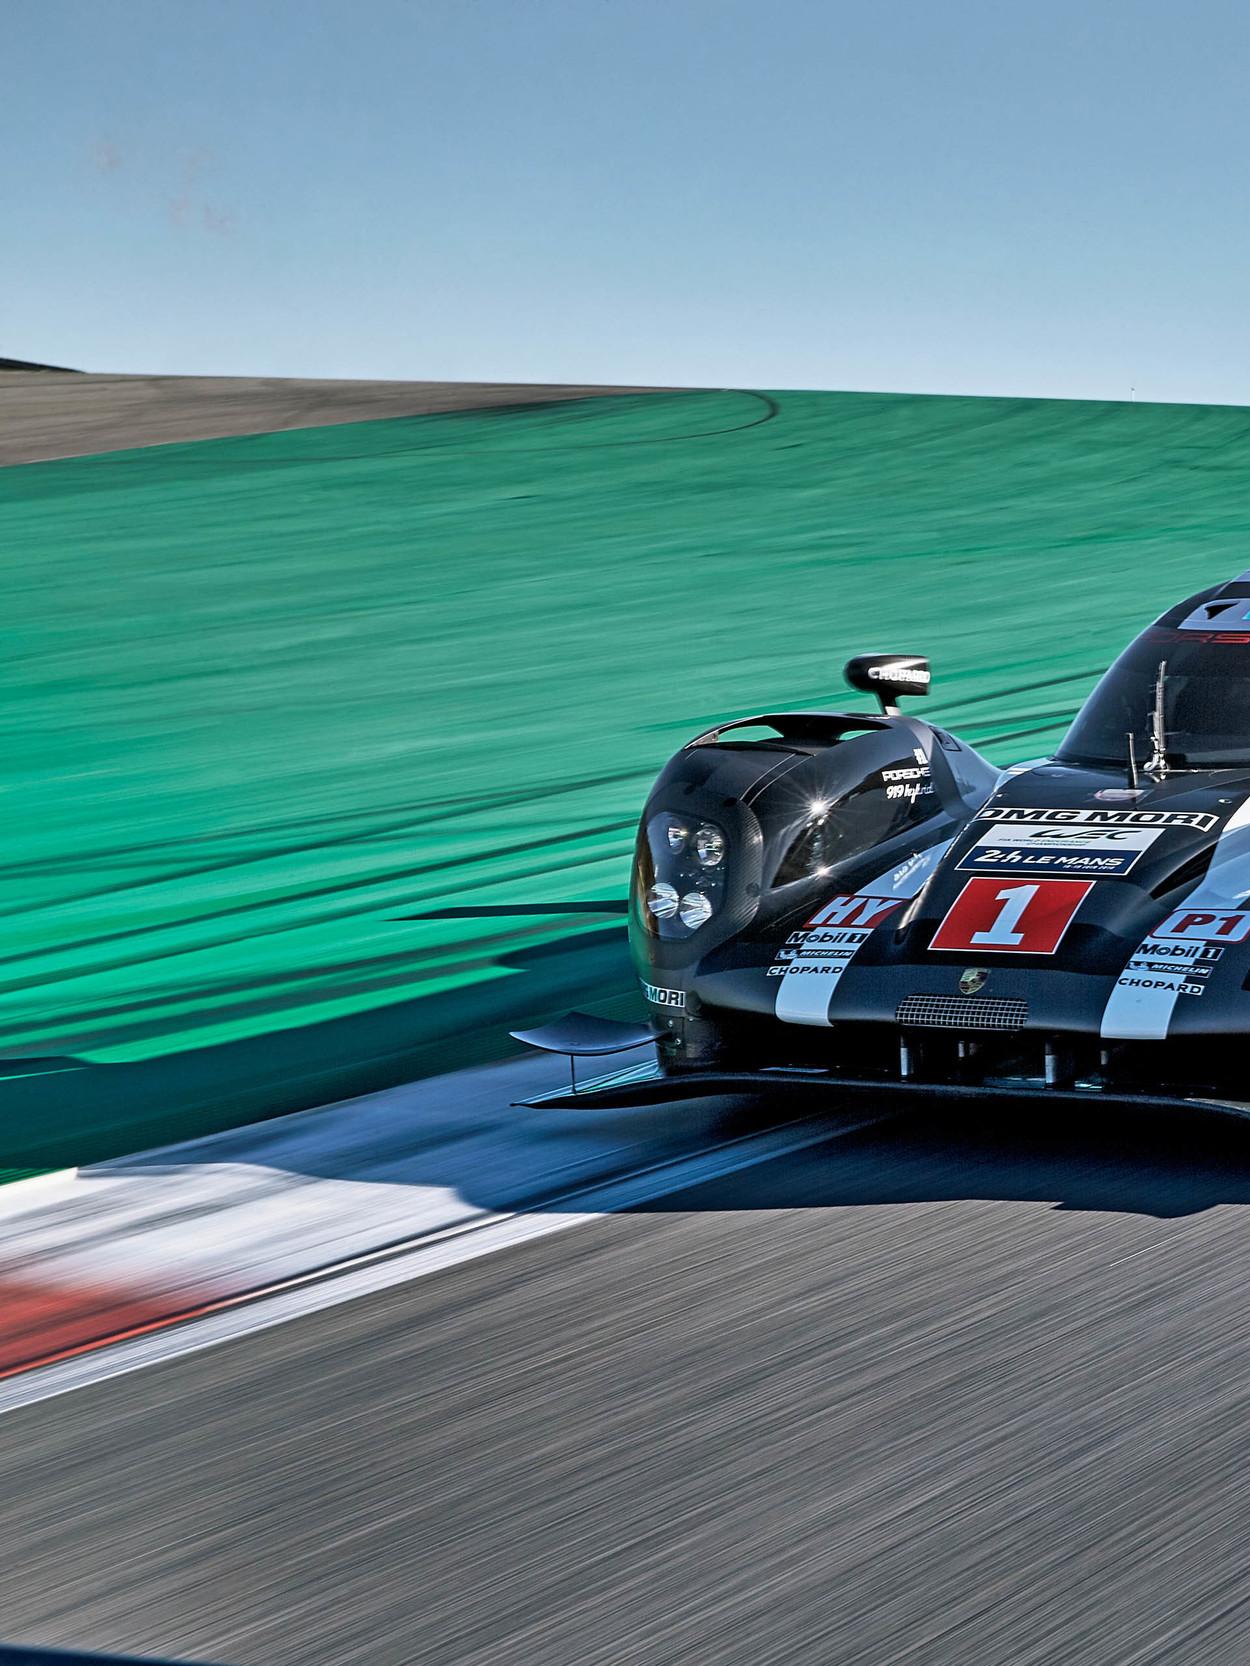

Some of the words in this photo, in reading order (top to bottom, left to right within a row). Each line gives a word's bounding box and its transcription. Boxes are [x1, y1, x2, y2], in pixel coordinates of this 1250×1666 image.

[882, 766, 931, 782] PORSCHE
[886, 783, 904, 799] 919
[977, 808, 1077, 821] DMG
[1084, 810, 1214, 829] MORI
[1029, 828, 1142, 840] WEC
[1053, 856, 1125, 867] MANS
[808, 896, 903, 926] HY
[969, 884, 1041, 945] 1
[1170, 913, 1246, 936] P1
[786, 932, 845, 944] Mobil
[1136, 943, 1199, 958] Mobil
[769, 966, 843, 975] CHOPARD
[1151, 963, 1210, 975] MICHELIN
[1118, 977, 1202, 994] CHOPARD
[650, 986, 684, 1006] MORI
